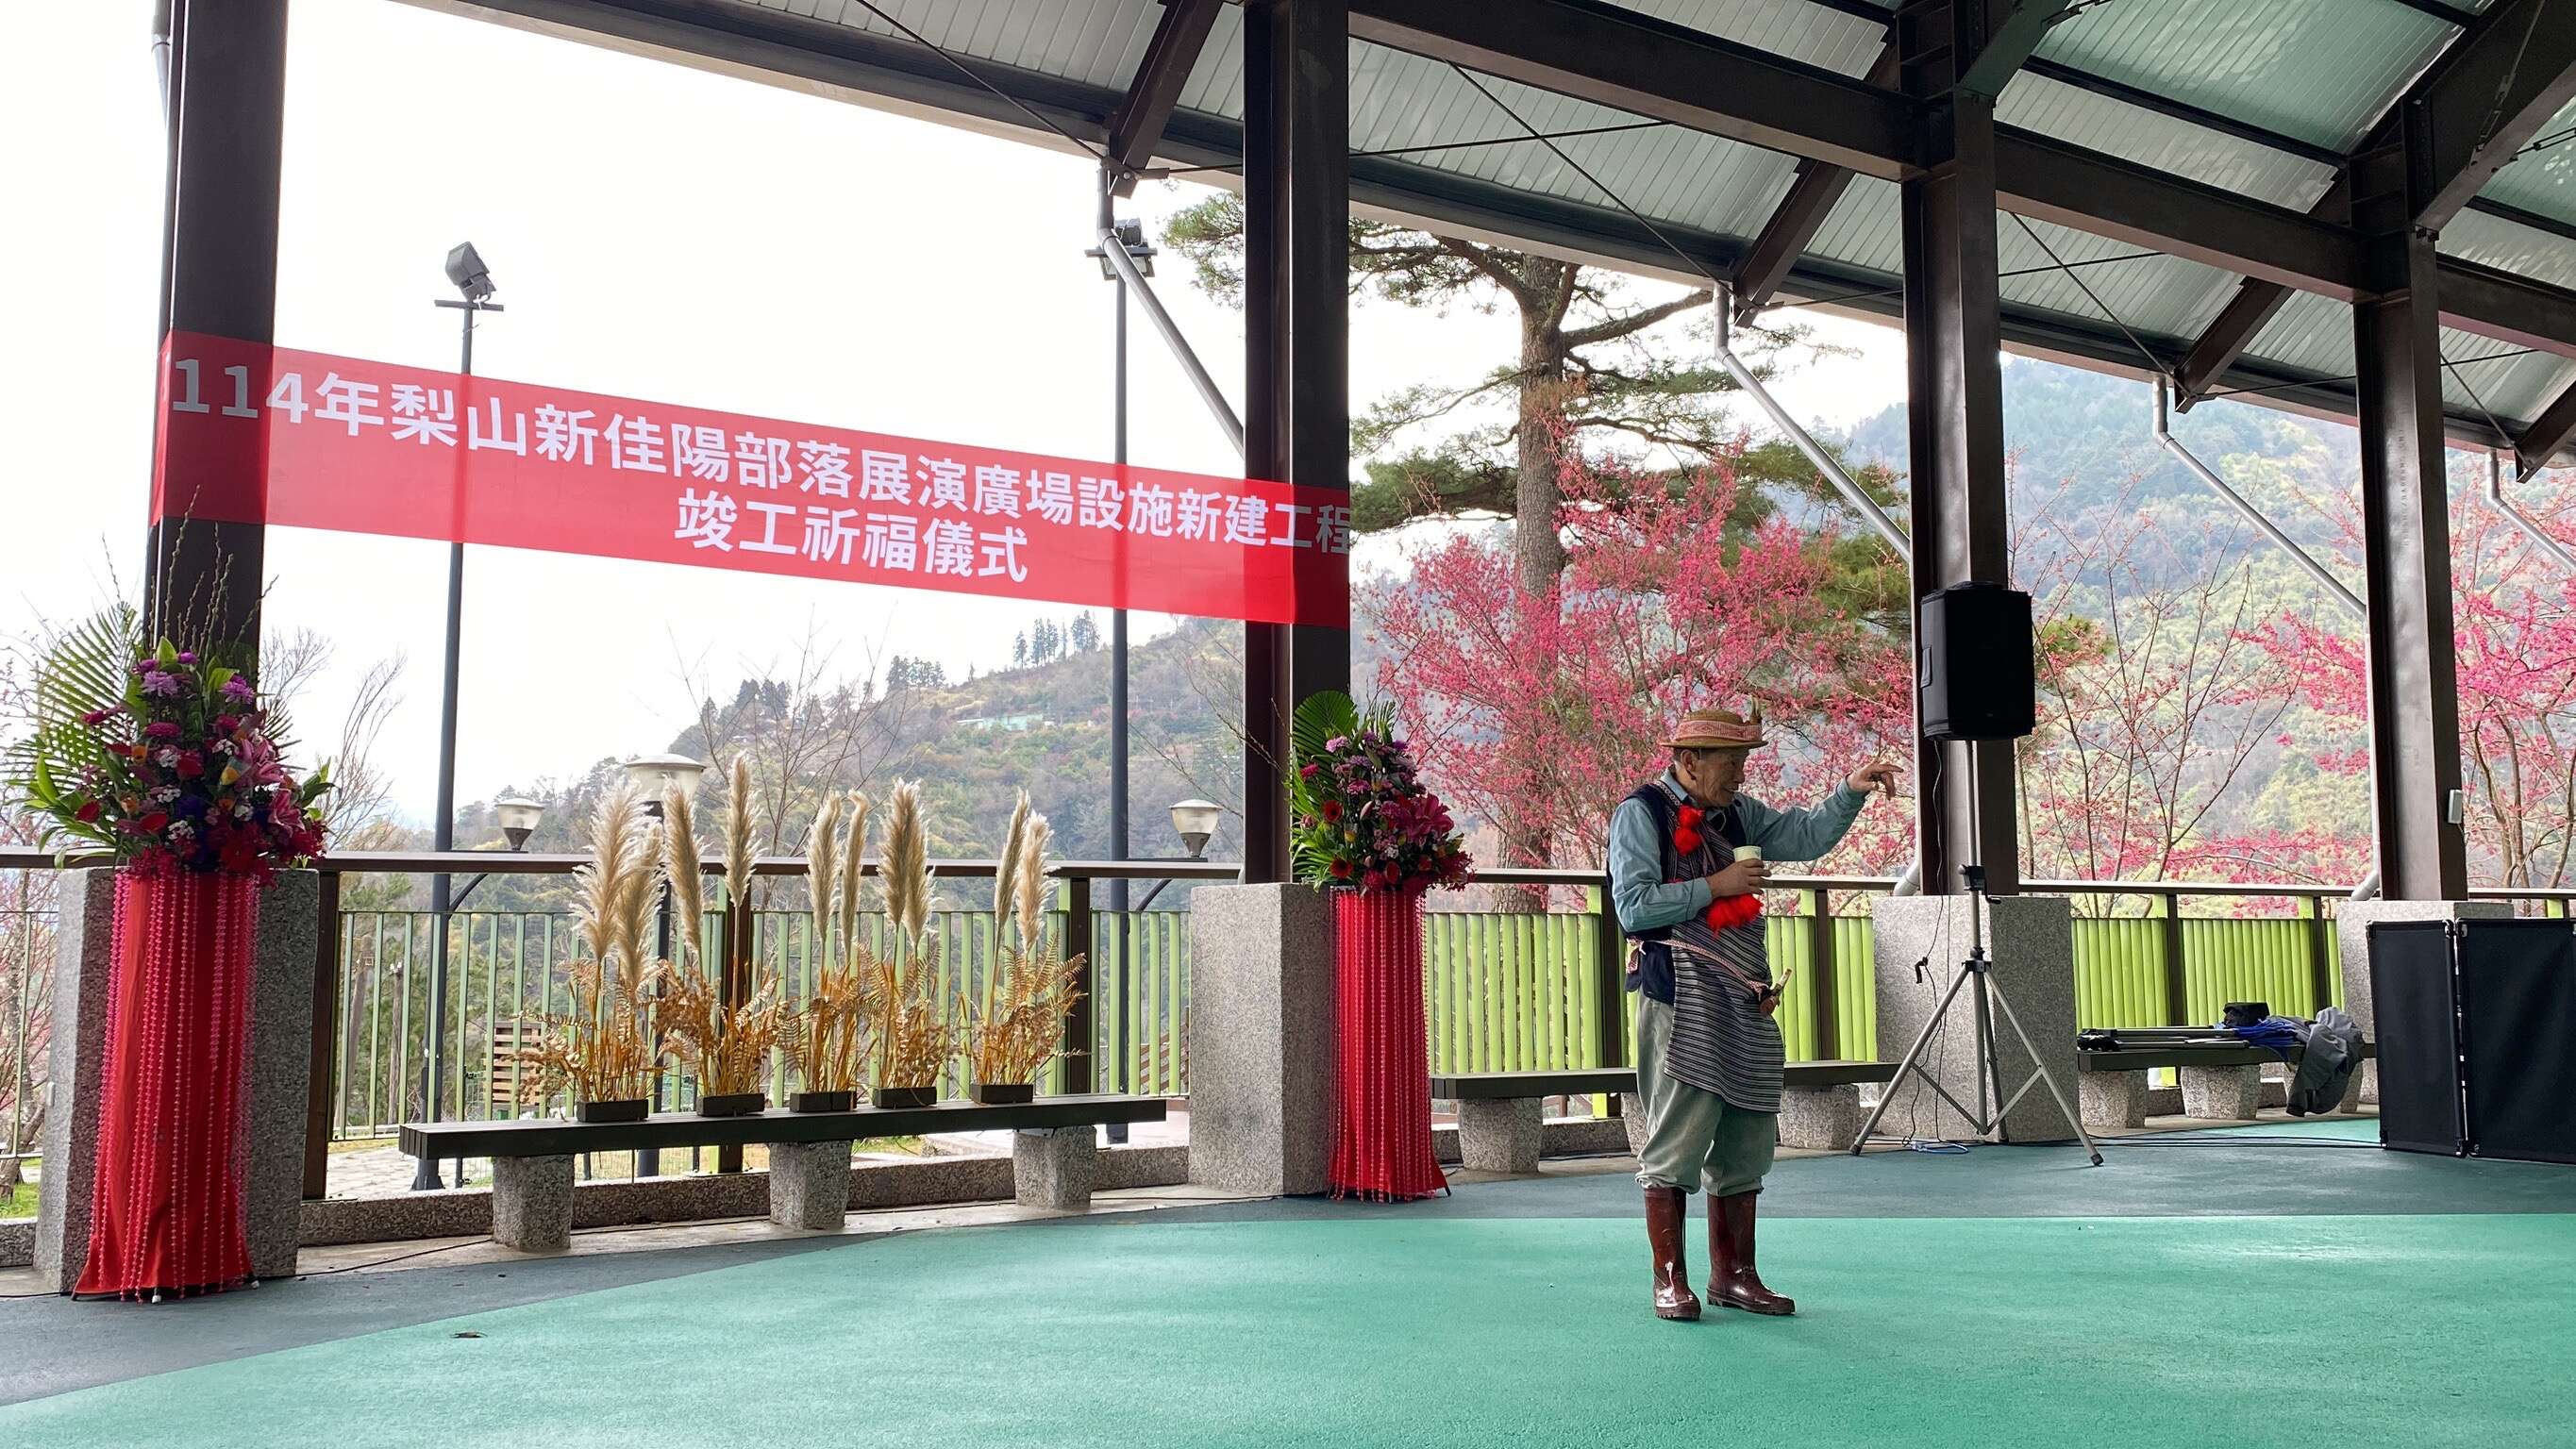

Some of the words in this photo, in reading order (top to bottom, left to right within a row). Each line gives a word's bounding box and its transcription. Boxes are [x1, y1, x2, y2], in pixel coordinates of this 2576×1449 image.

[172, 358, 1350, 555] 114年梨山新佳陽部落展演廣場設施新建工程
[674, 487, 1029, 582] 竣工祈福儀式
